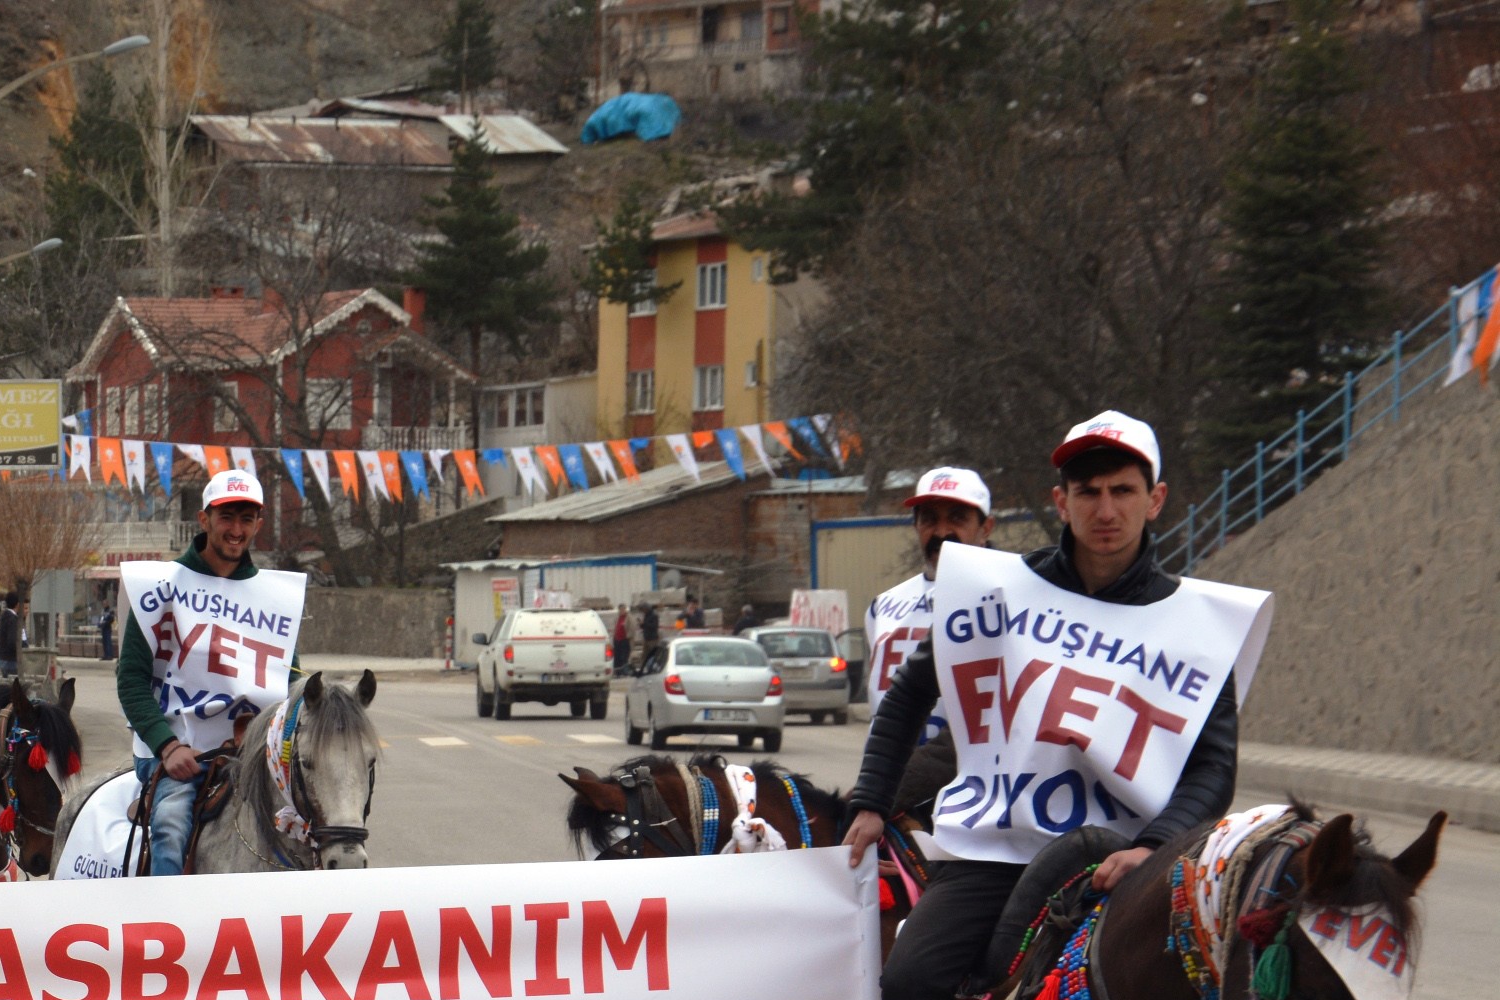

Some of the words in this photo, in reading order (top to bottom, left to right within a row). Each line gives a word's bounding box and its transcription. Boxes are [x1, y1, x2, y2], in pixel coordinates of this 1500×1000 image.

[17, 455, 37, 465] 28
[227, 484, 250, 492] EVET
[929, 480, 959, 491] EVET
[140, 579, 292, 637] GÜMÜŞHANE
[151, 611, 285, 689] EVET
[945, 595, 1211, 702] GÜMÜŞHANE
[951, 656, 1189, 782] EVET
[74, 853, 108, 879] GÜÇLÜ
